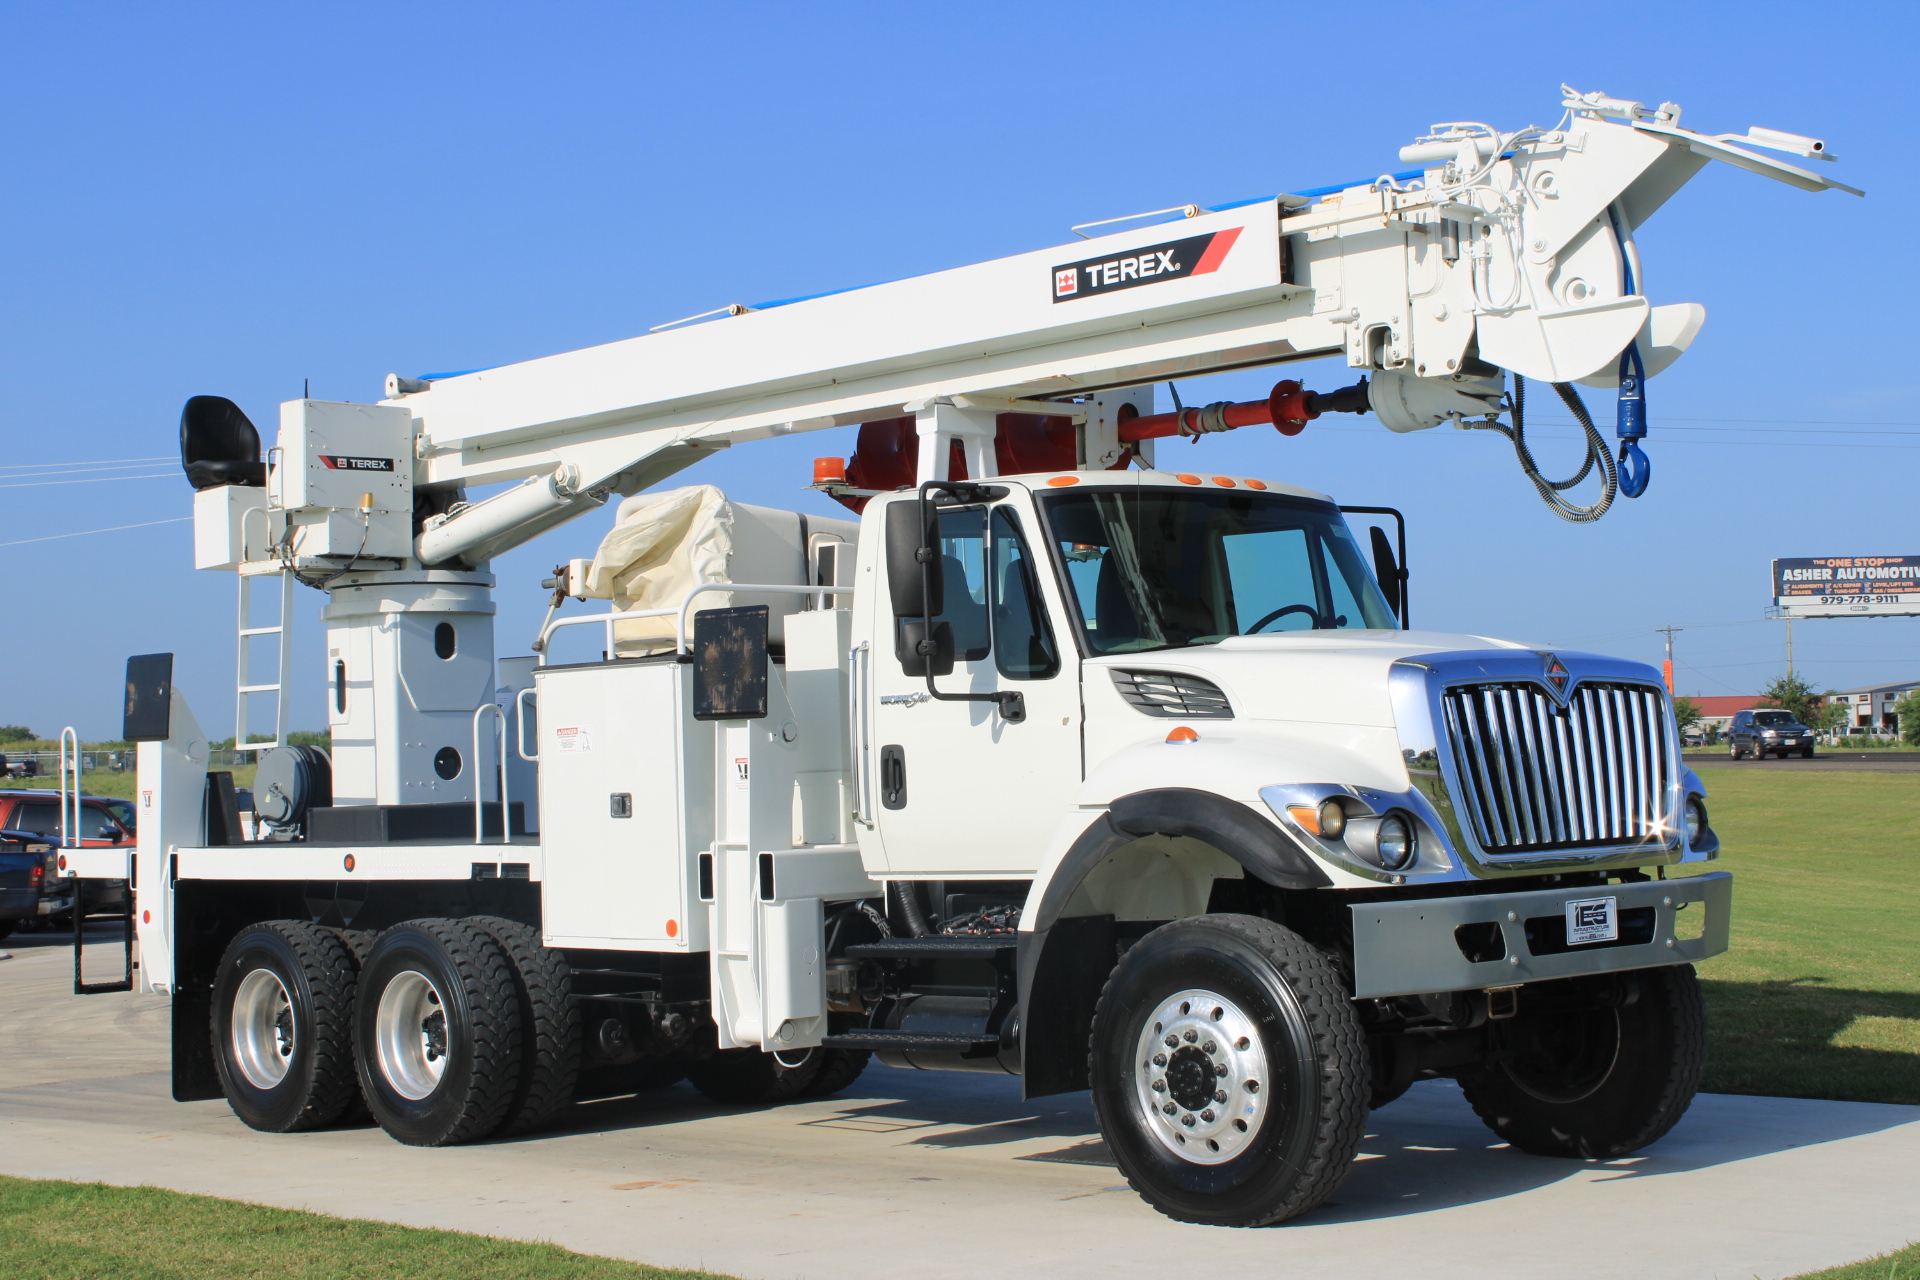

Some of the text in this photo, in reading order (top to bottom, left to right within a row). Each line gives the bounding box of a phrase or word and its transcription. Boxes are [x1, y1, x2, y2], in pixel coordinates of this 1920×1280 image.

[1085, 249, 1175, 287] TEREX
[350, 459, 386, 469] TEREX
[1827, 559, 1853, 567] ONE
[1854, 558, 1885, 566] STOP
[1783, 568, 1832, 581] ASHER
[1821, 595, 1899, 604] 979-778-9111
